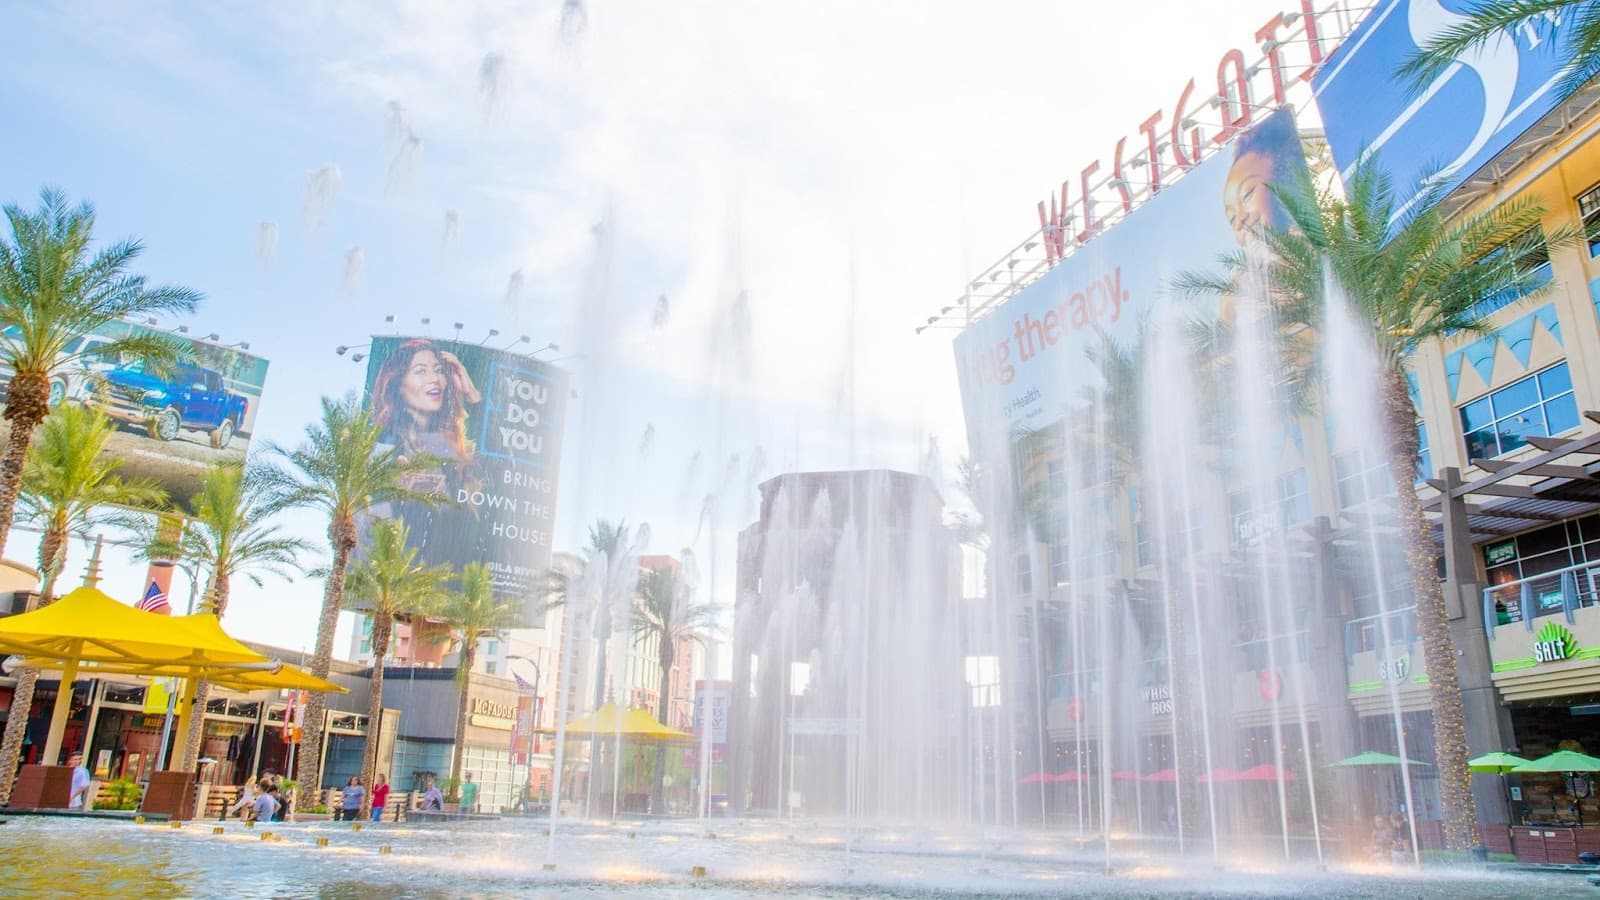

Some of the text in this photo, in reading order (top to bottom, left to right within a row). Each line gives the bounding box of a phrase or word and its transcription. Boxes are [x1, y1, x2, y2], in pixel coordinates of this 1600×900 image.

[1013, 266, 1130, 363] therapy.
[504, 375, 548, 405] YOU
[508, 403, 540, 428] DO
[499, 426, 543, 455] YOU
[503, 469, 552, 494] BRING
[456, 488, 551, 520] DOWN THE
[492, 521, 546, 546] HOUSE
